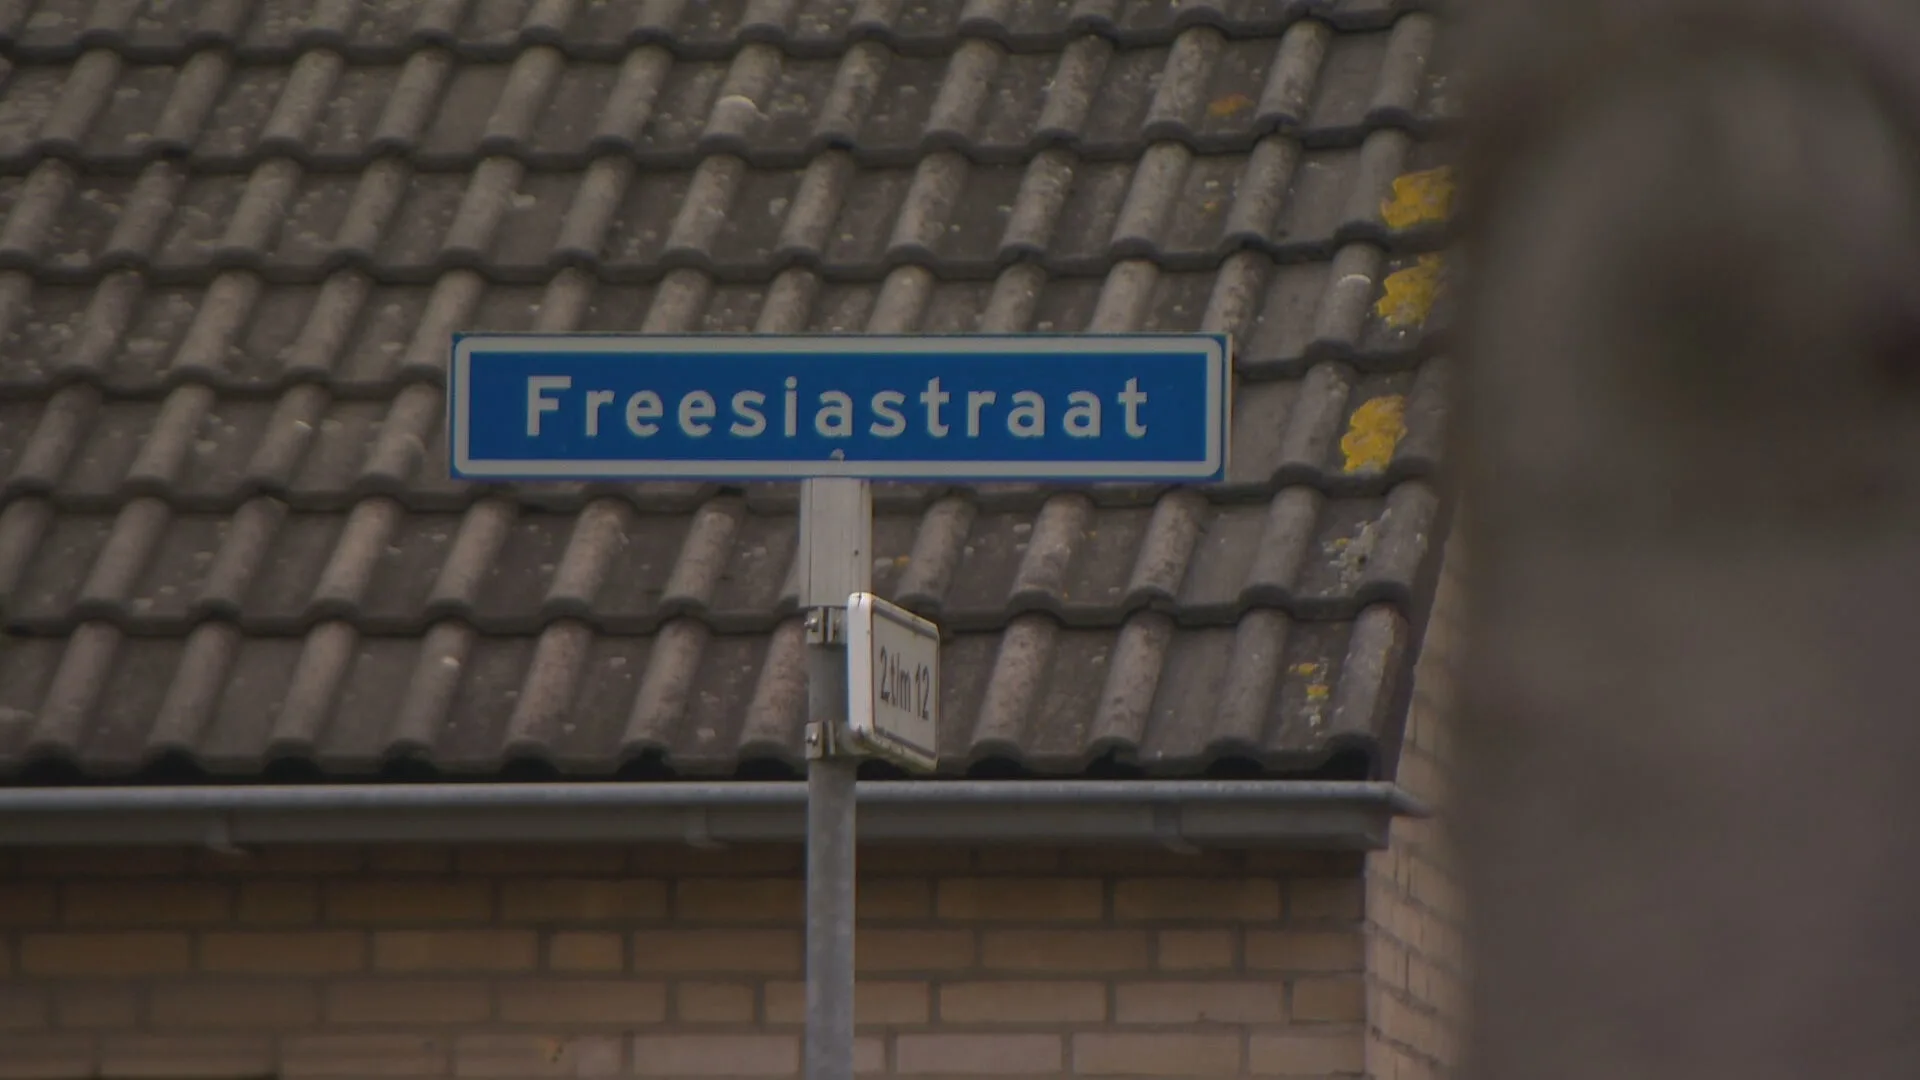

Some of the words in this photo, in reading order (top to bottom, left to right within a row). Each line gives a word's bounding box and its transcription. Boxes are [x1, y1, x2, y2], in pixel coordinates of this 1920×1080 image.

[526, 376, 1147, 438] Freesiastraat
[880, 645, 890, 703] 2
[890, 652, 911, 713] t/m
[915, 662, 930, 721] 12
